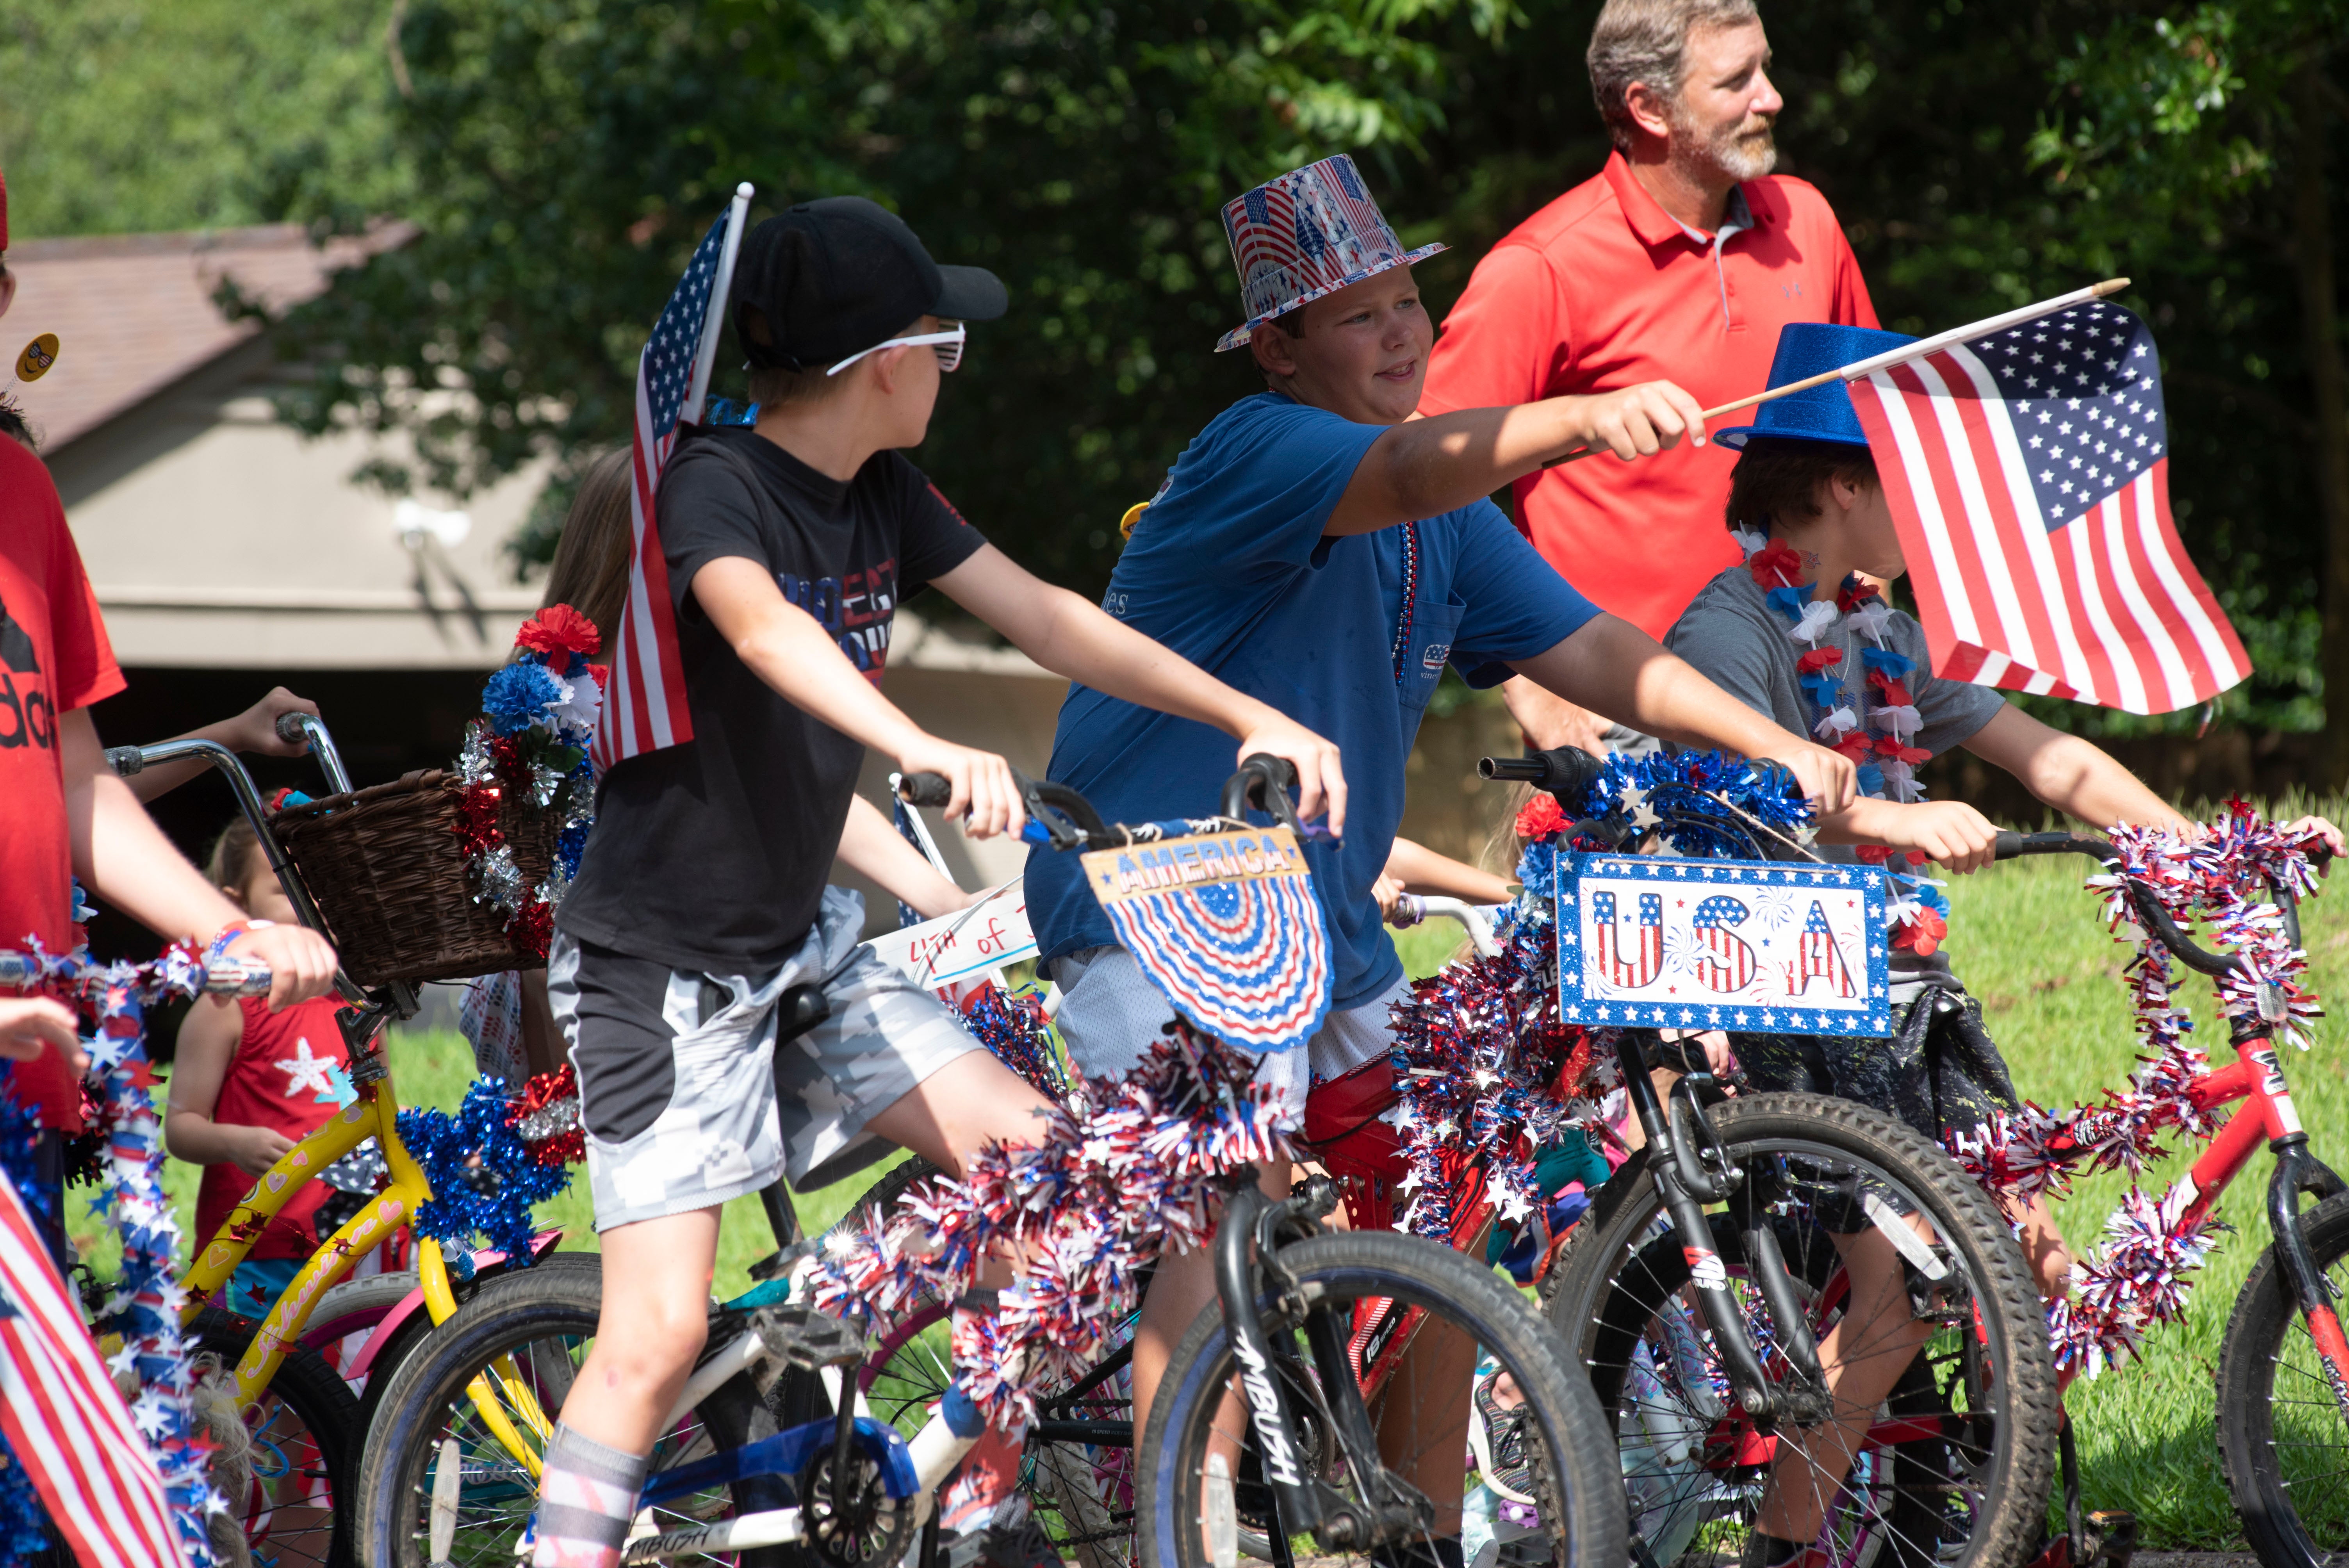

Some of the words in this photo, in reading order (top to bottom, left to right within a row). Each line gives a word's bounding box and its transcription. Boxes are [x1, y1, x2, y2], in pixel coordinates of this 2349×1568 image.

[1116, 834, 1292, 894] AMERICA
[910, 929, 957, 974] 4TH
[977, 918, 1005, 955] of
[1593, 891, 1856, 998] USA
[1367, 1334, 1380, 1364] 18
[1380, 1317, 1395, 1343] SPEED
[1232, 1326, 1301, 1486] AMBUSH
